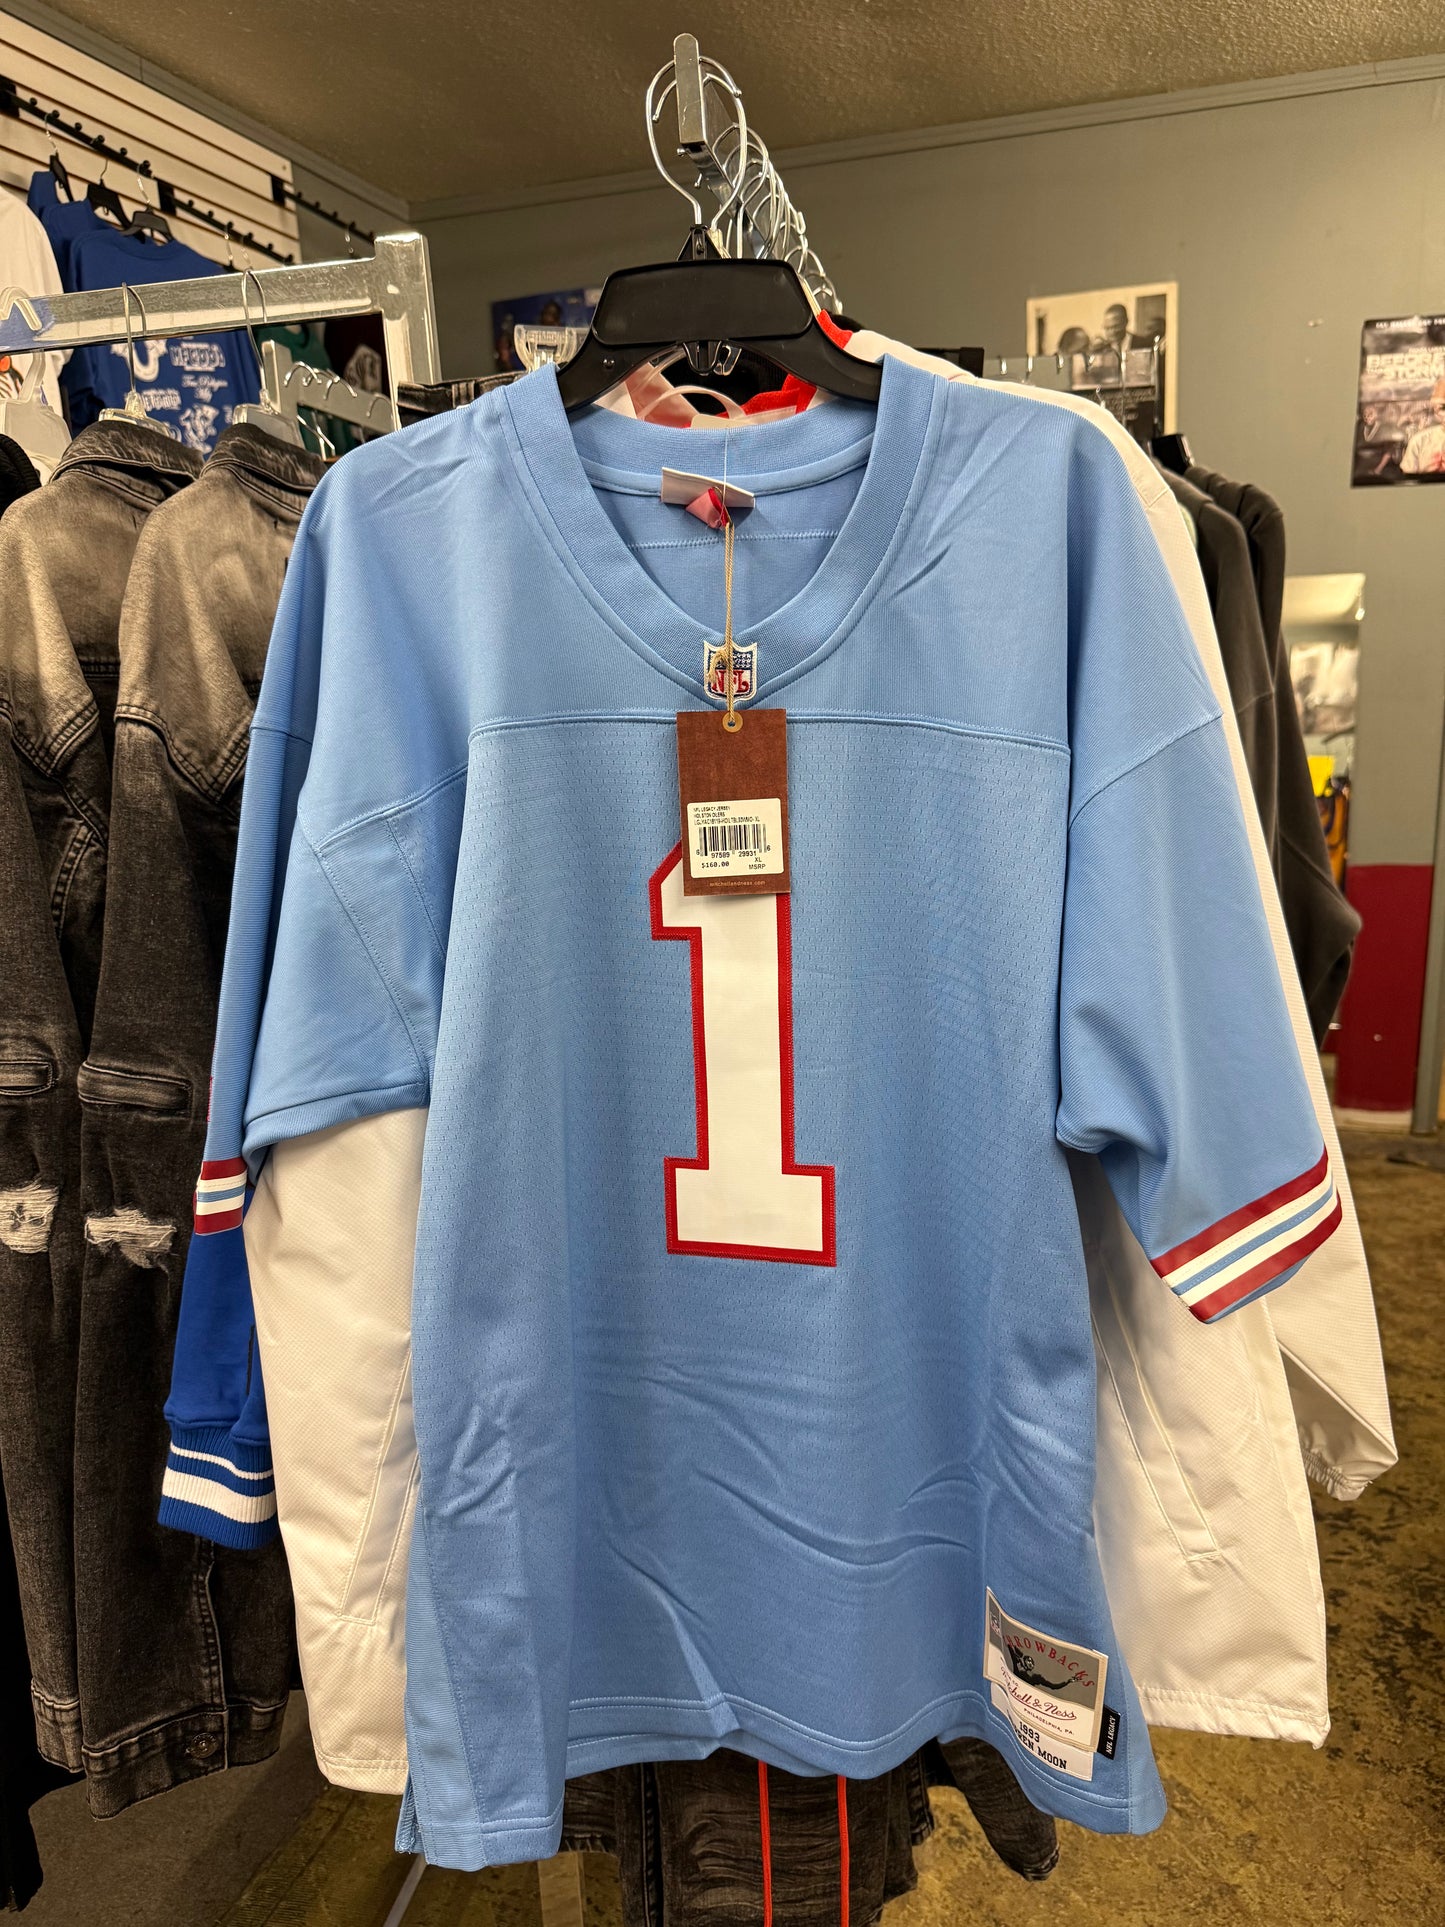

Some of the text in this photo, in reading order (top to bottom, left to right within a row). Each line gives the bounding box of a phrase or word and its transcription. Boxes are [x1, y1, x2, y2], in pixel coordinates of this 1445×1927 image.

[648, 838, 837, 1268] 1
[1023, 1707, 1063, 1733] PHILADELPHIA,
[1032, 1698, 1043, 1710] &
[1043, 1701, 1077, 1720] Ness
[1011, 1722, 1068, 1770] REN MOON
[1019, 1720, 1041, 1743] 1993
[1105, 1715, 1117, 1755] NFL LEGACY
